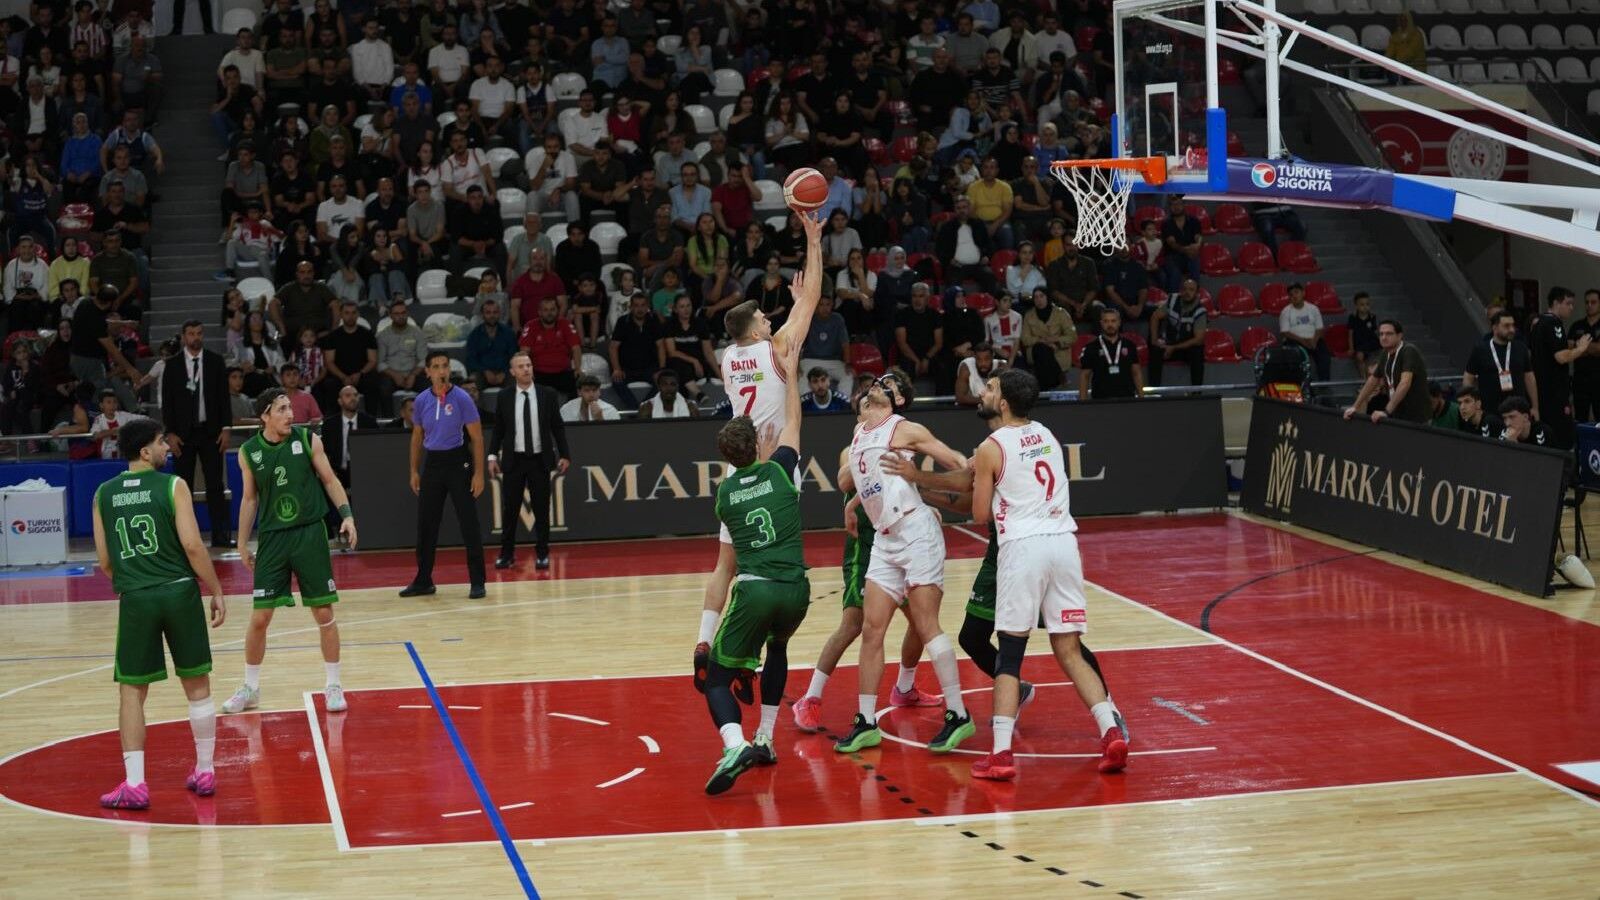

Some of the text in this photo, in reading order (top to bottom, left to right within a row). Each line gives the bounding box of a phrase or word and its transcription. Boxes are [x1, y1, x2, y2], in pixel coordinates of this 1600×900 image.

[731, 359, 758, 372] BATIN
[739, 385, 757, 417] 7
[1020, 434, 1044, 449] ARDA
[274, 465, 289, 487] 2
[858, 451, 867, 475] 6
[1034, 460, 1056, 501] 9
[745, 506, 777, 548] 3
[1431, 479, 1517, 544] OTEL
[115, 513, 159, 560] 13
